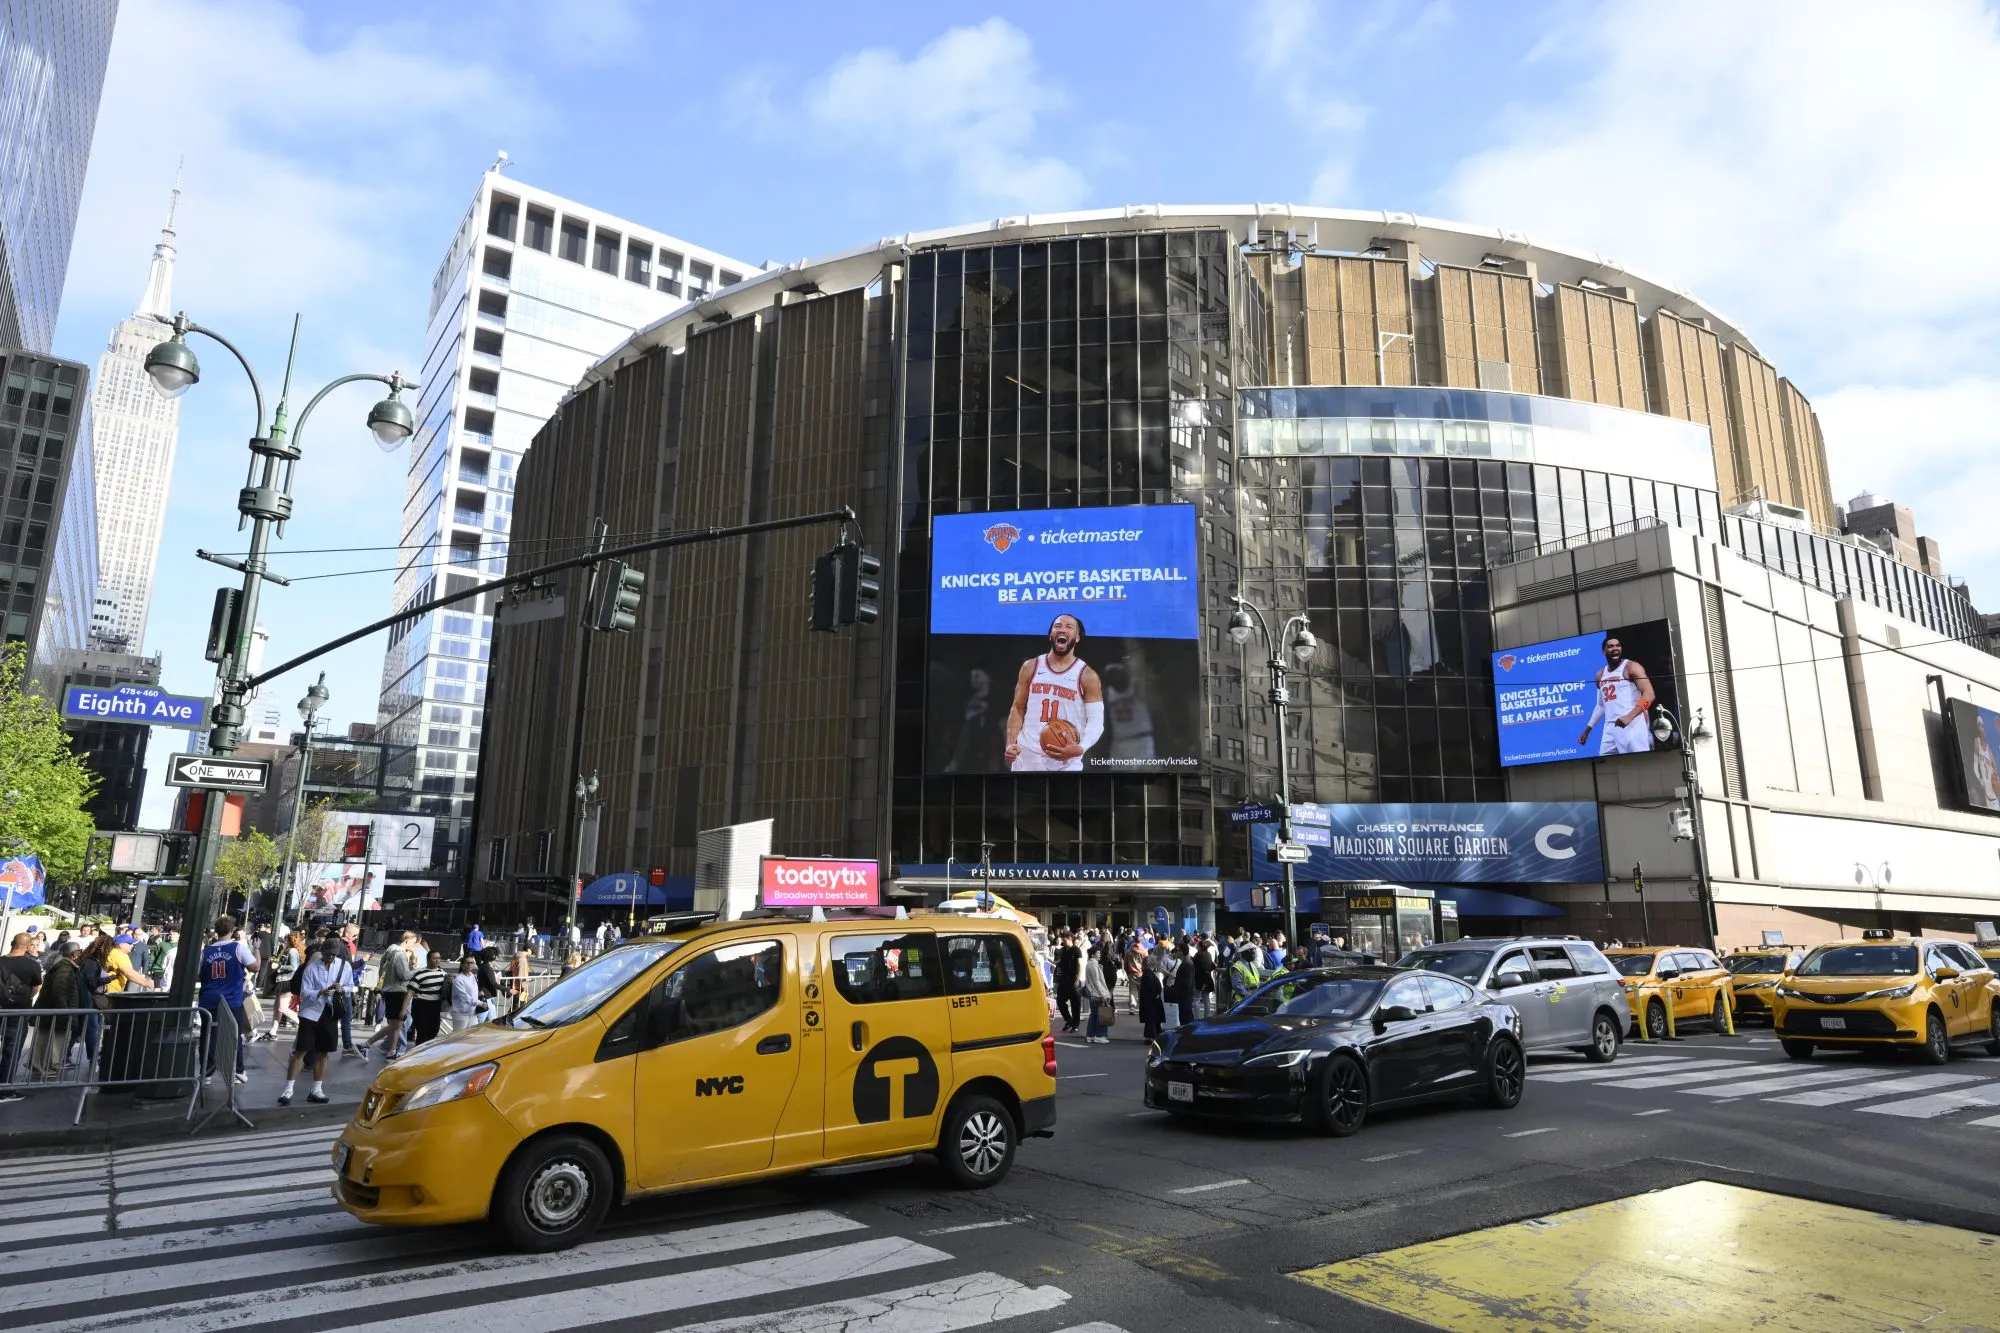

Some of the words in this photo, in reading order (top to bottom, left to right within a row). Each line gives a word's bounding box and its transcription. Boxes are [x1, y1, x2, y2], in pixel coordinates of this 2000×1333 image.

[1040, 528, 1143, 544] ticketmaster
[941, 573, 1000, 588] KNICKS
[1004, 571, 1075, 585] PLAYOFF
[1079, 568, 1187, 582] BASKETBALL.
[998, 589, 1018, 602] BE
[1021, 588, 1033, 601] A
[1037, 587, 1078, 600] PART
[1082, 586, 1105, 599] OF
[1109, 585, 1127, 598] IT.
[1526, 648, 1581, 664] ticketmaster
[120, 687, 136, 695] 478
[142, 689, 158, 697] 460
[1031, 683, 1051, 694] NEW
[1500, 688, 1537, 702] KNICKS
[1539, 680, 1586, 696] PLAYOFF
[1602, 684, 1617, 702] 32
[78, 693, 146, 714] Eighth
[152, 701, 192, 718] Ave
[1040, 699, 1059, 722] 11
[1501, 694, 1567, 711] BASKETBALL.
[1502, 714, 1514, 724] BE
[1517, 713, 1524, 722] A
[1526, 709, 1552, 721] PART
[1554, 706, 1569, 717] OF
[1571, 704, 1584, 714] IT.
[1090, 757, 1198, 766] ticketmaster.com/knicks
[1504, 748, 1577, 761] ticketmaster.com/knicks
[189, 765, 214, 776] ONE
[227, 769, 254, 779] WAY
[1231, 810, 1248, 820] West
[1250, 809, 1263, 819] 33rd
[1264, 809, 1271, 818] St
[1295, 809, 1314, 820] Eighth
[1315, 811, 1327, 821] Ave
[1296, 831, 1305, 840] Joe
[1306, 832, 1318, 841] Louis
[1356, 824, 1394, 833] CHASE
[1412, 823, 1484, 832] ENTRANCE
[402, 823, 421, 850] 2
[1535, 824, 1577, 859] C
[1454, 835, 1509, 855] GARDEN
[774, 865, 868, 889] todaytix
[971, 868, 1076, 878] PENNSYLVANIA
[1083, 869, 1140, 879] STATION
[615, 879, 627, 892] D
[774, 890, 824, 900] Broadway's
[826, 891, 844, 899] best
[845, 891, 868, 899] ticket
[1353, 897, 1378, 908] TAXI
[1400, 898, 1418, 907] TAXI
[211, 960, 226, 979] 11
[695, 1075, 744, 1097] NYC
